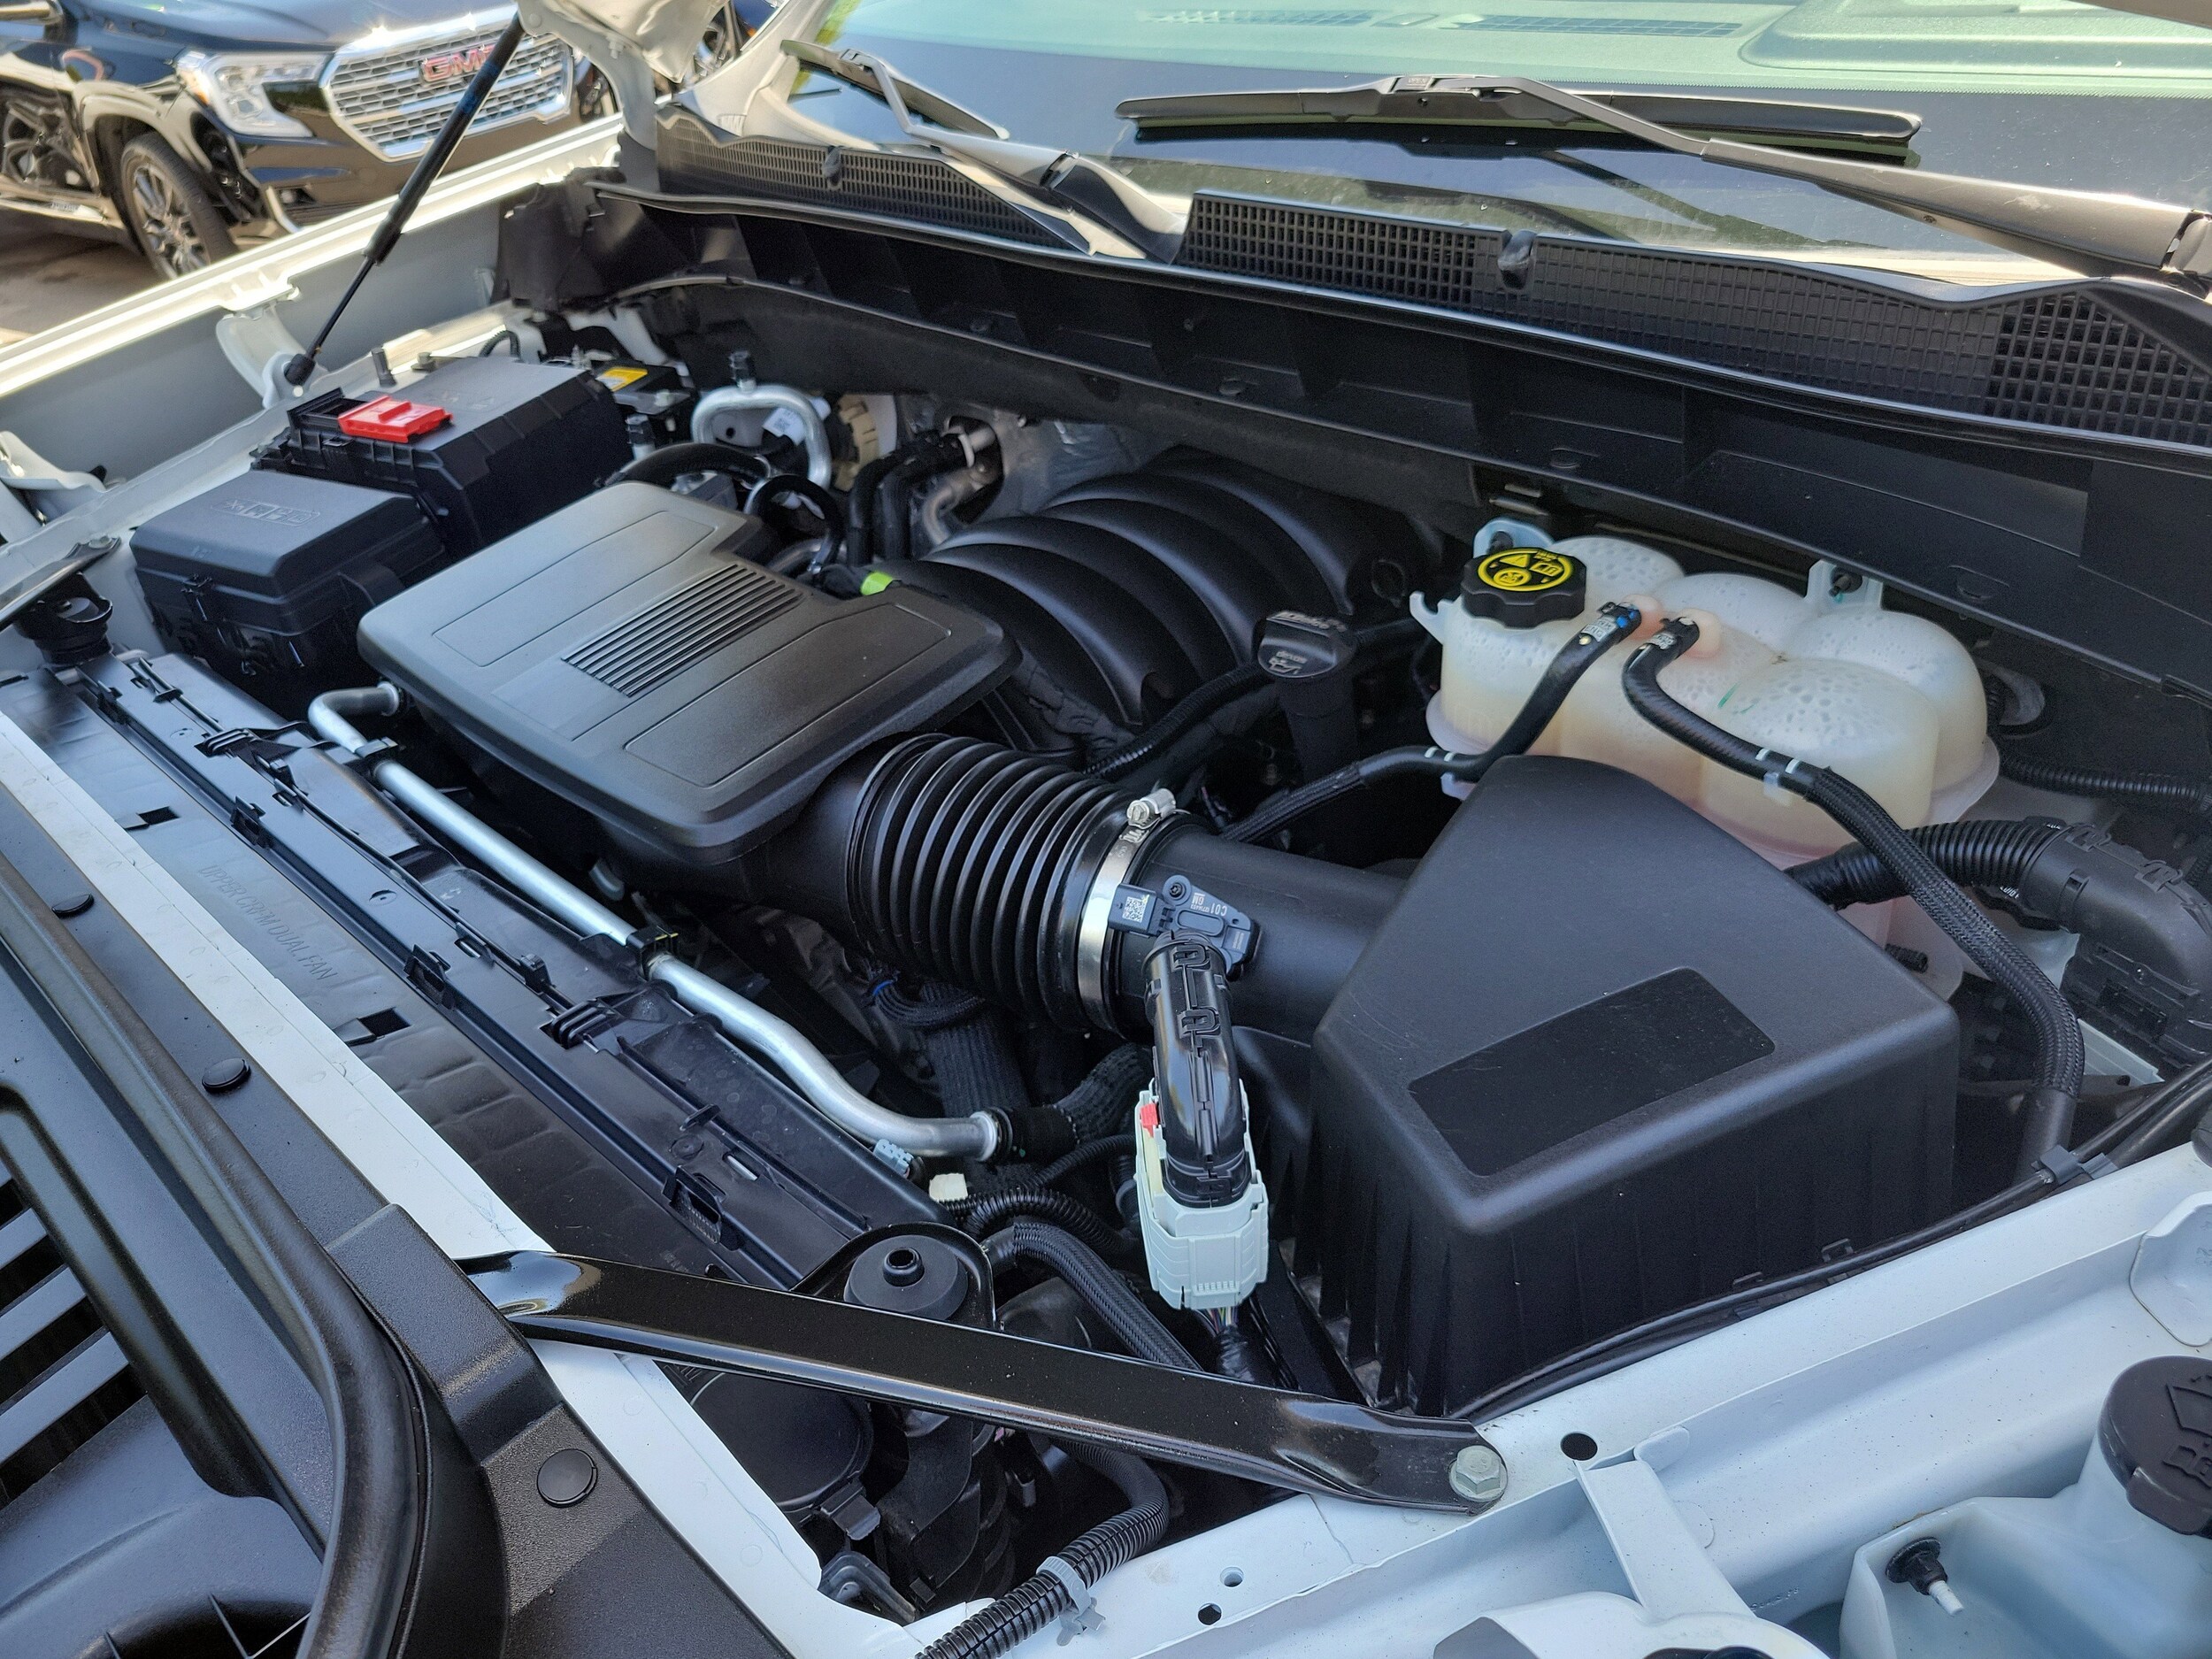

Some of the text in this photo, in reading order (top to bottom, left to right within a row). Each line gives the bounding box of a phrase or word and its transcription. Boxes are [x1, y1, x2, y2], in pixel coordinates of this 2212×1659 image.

[200, 864, 246, 898] UPPER
[267, 924, 310, 957] DUAL
[298, 954, 338, 980] FAN
[1192, 894, 1204, 905] GM
